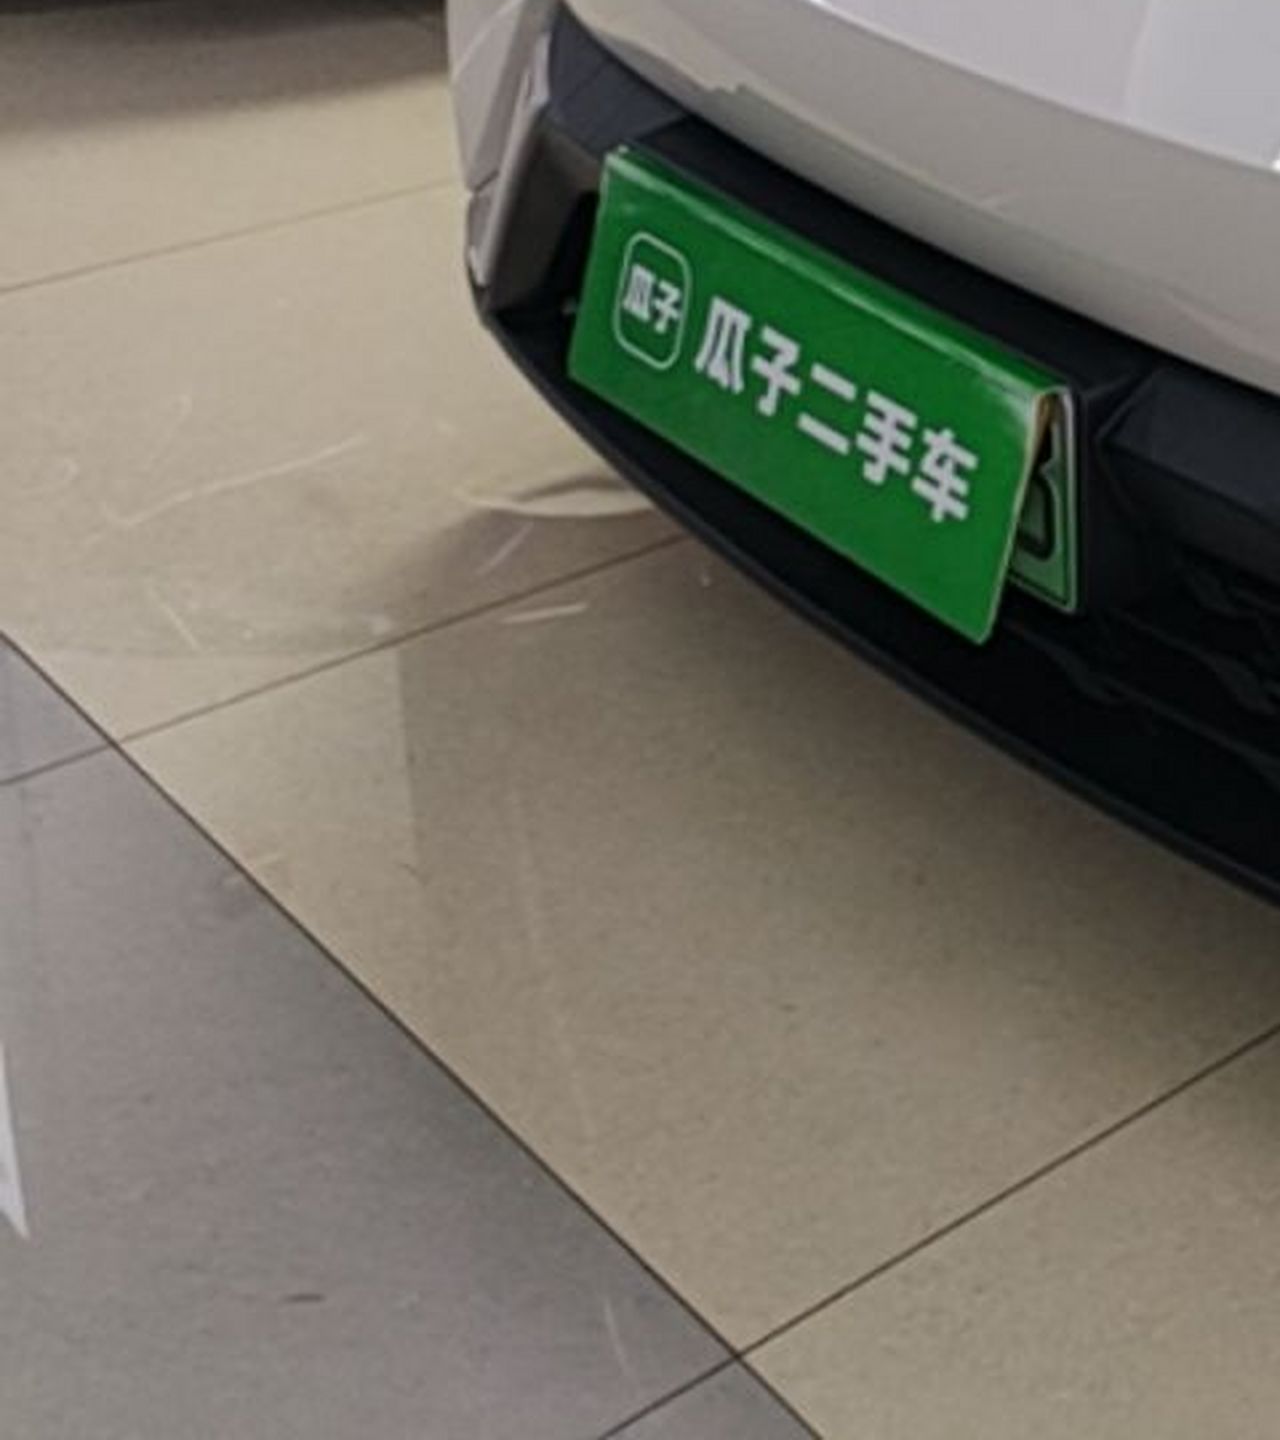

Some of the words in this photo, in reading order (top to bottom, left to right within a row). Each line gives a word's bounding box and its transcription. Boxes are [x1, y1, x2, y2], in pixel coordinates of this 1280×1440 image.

[622, 264, 681, 333] 瓜子
[696, 297, 977, 522] 瓜子二手车
